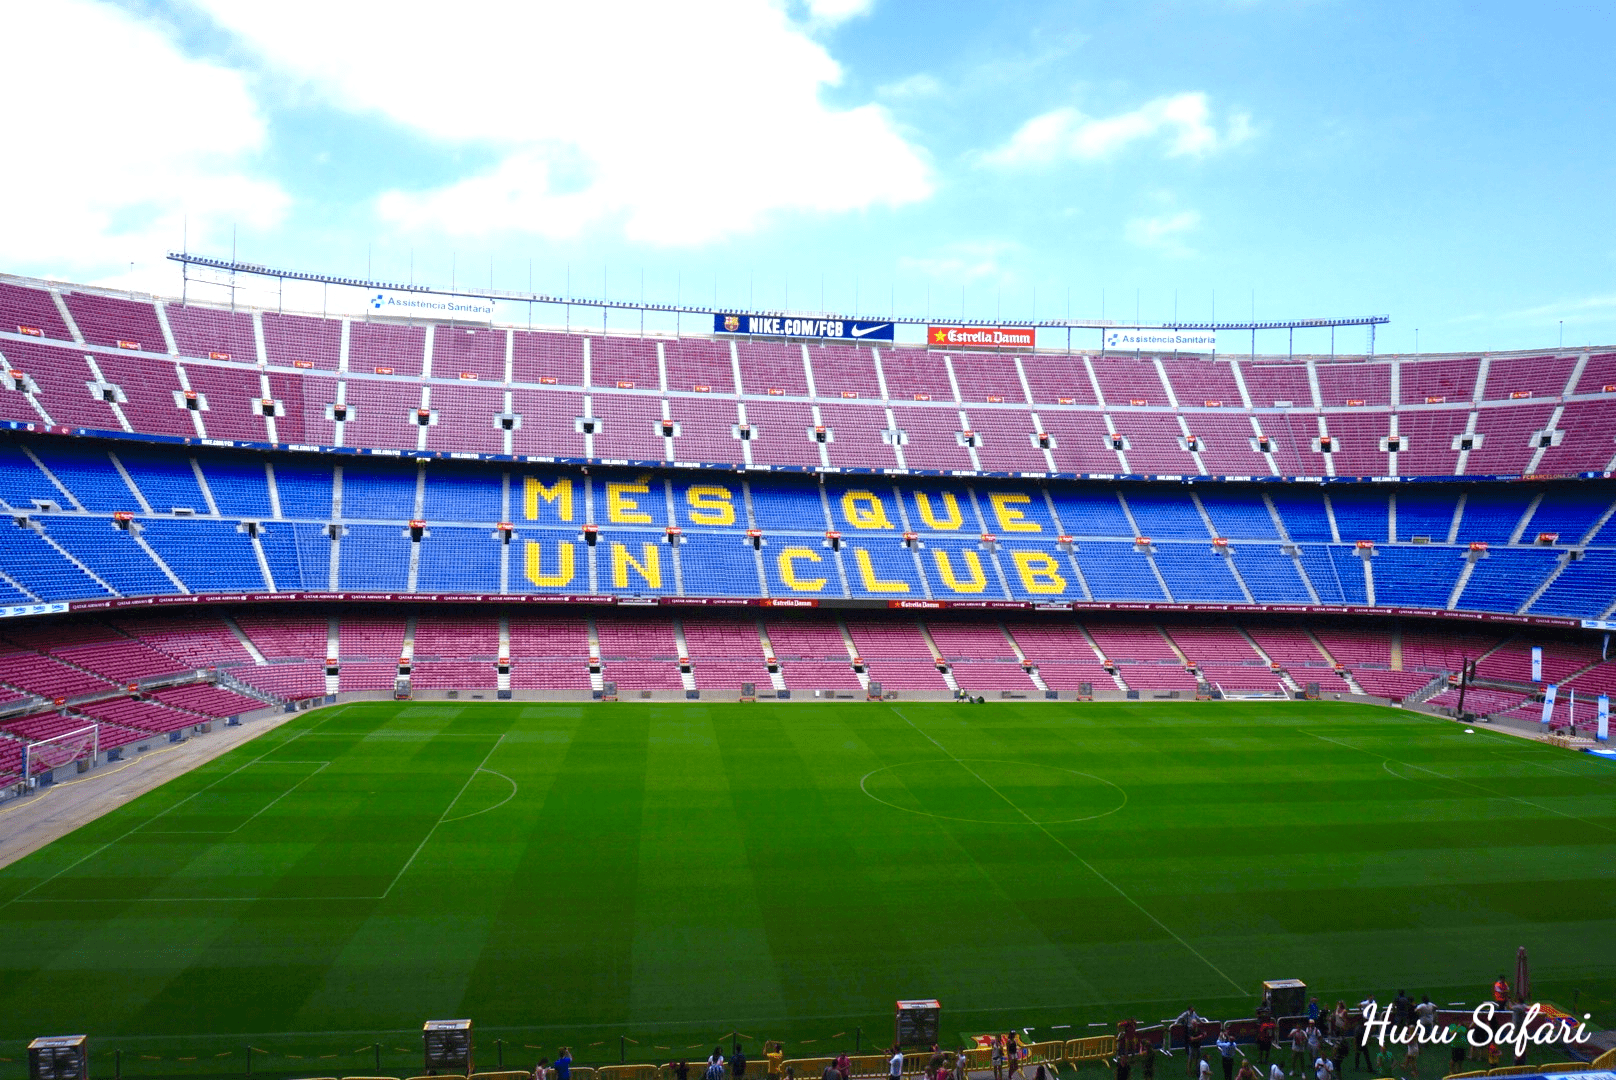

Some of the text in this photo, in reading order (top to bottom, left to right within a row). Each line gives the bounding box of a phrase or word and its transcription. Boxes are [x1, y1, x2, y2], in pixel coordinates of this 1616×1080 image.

[388, 297, 446, 310] Assistència
[749, 316, 844, 337] NIKE.COM/FCB
[948, 329, 1031, 344] Estrella Damm
[1122, 335, 1175, 343] Assistència
[524, 474, 1042, 532] MÉS QUE
[524, 539, 1067, 594] UN CLUB
